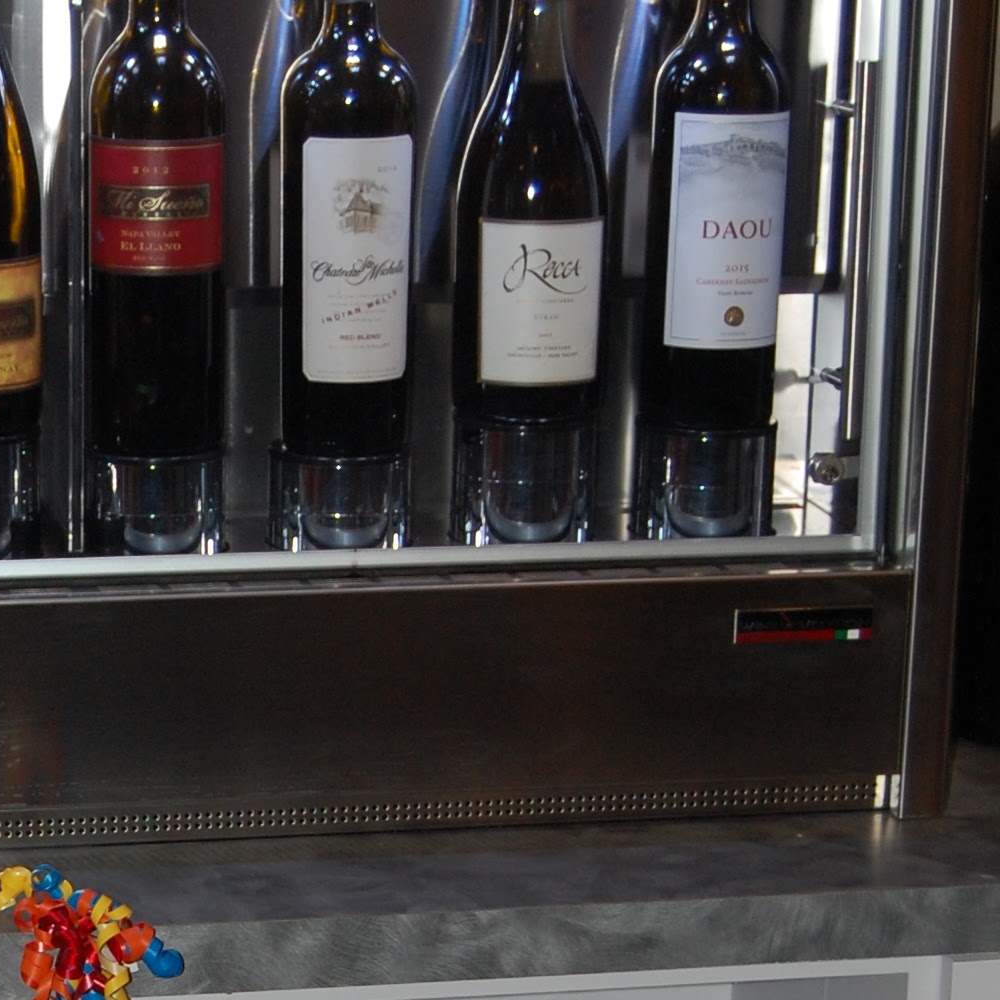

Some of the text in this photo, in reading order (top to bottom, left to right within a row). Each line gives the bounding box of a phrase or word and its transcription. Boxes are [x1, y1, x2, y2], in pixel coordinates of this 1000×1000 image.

[702, 218, 772, 239] DAOU
[724, 264, 750, 273] 2015
[322, 306, 362, 325] INDIAN
